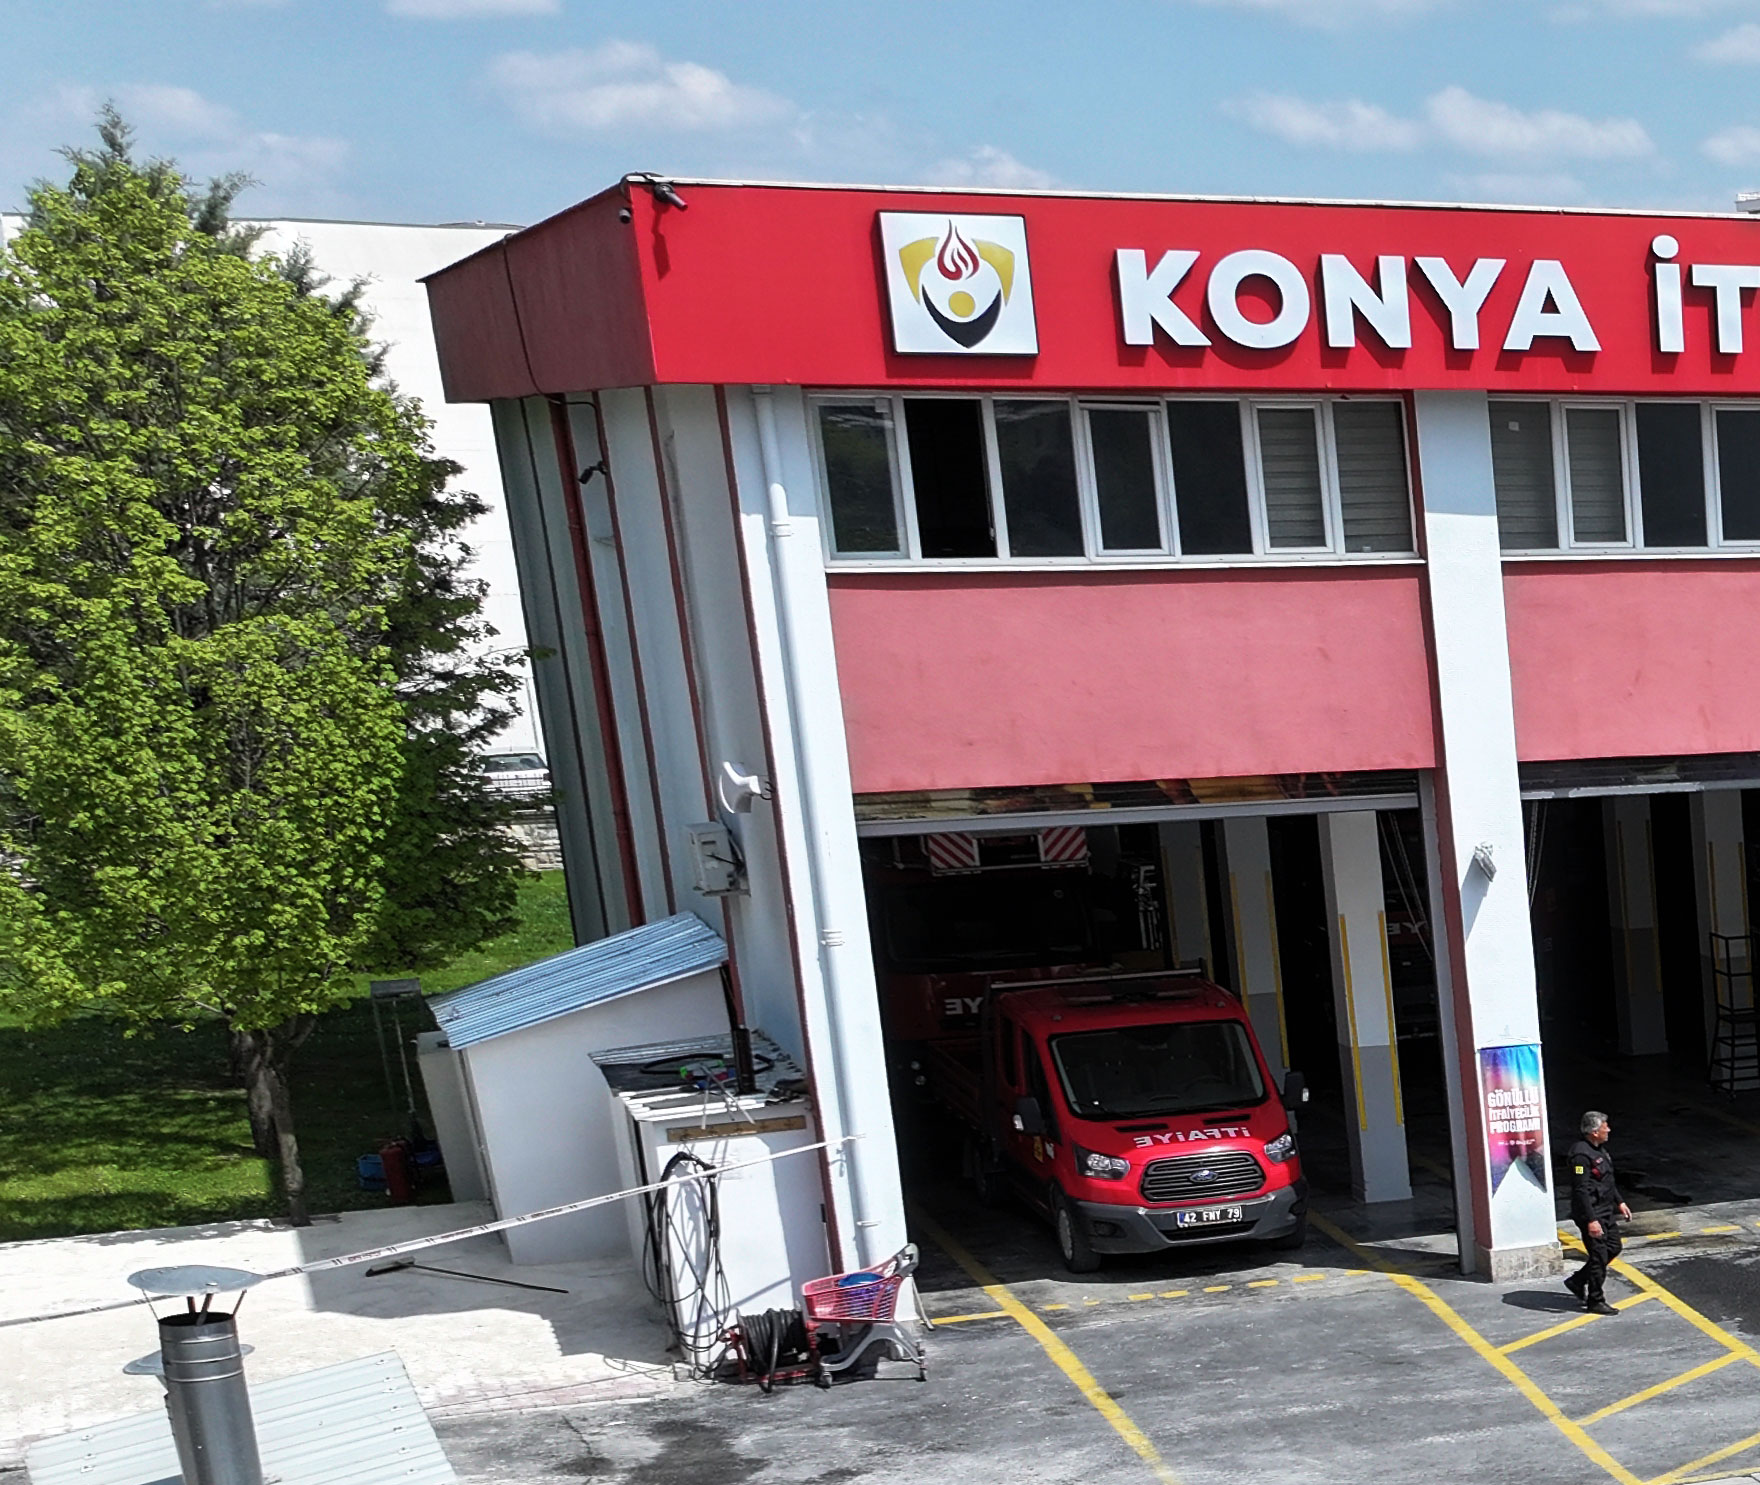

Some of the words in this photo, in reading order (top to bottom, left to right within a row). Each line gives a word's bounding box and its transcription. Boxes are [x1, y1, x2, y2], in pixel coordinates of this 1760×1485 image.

[1116, 248, 1602, 352] KONYA
[1487, 1086, 1540, 1108] GÖNÜLLÜ
[1184, 1212, 1197, 1223] 42
[1202, 1210, 1221, 1222] FNY
[1227, 1208, 1240, 1219] 79
